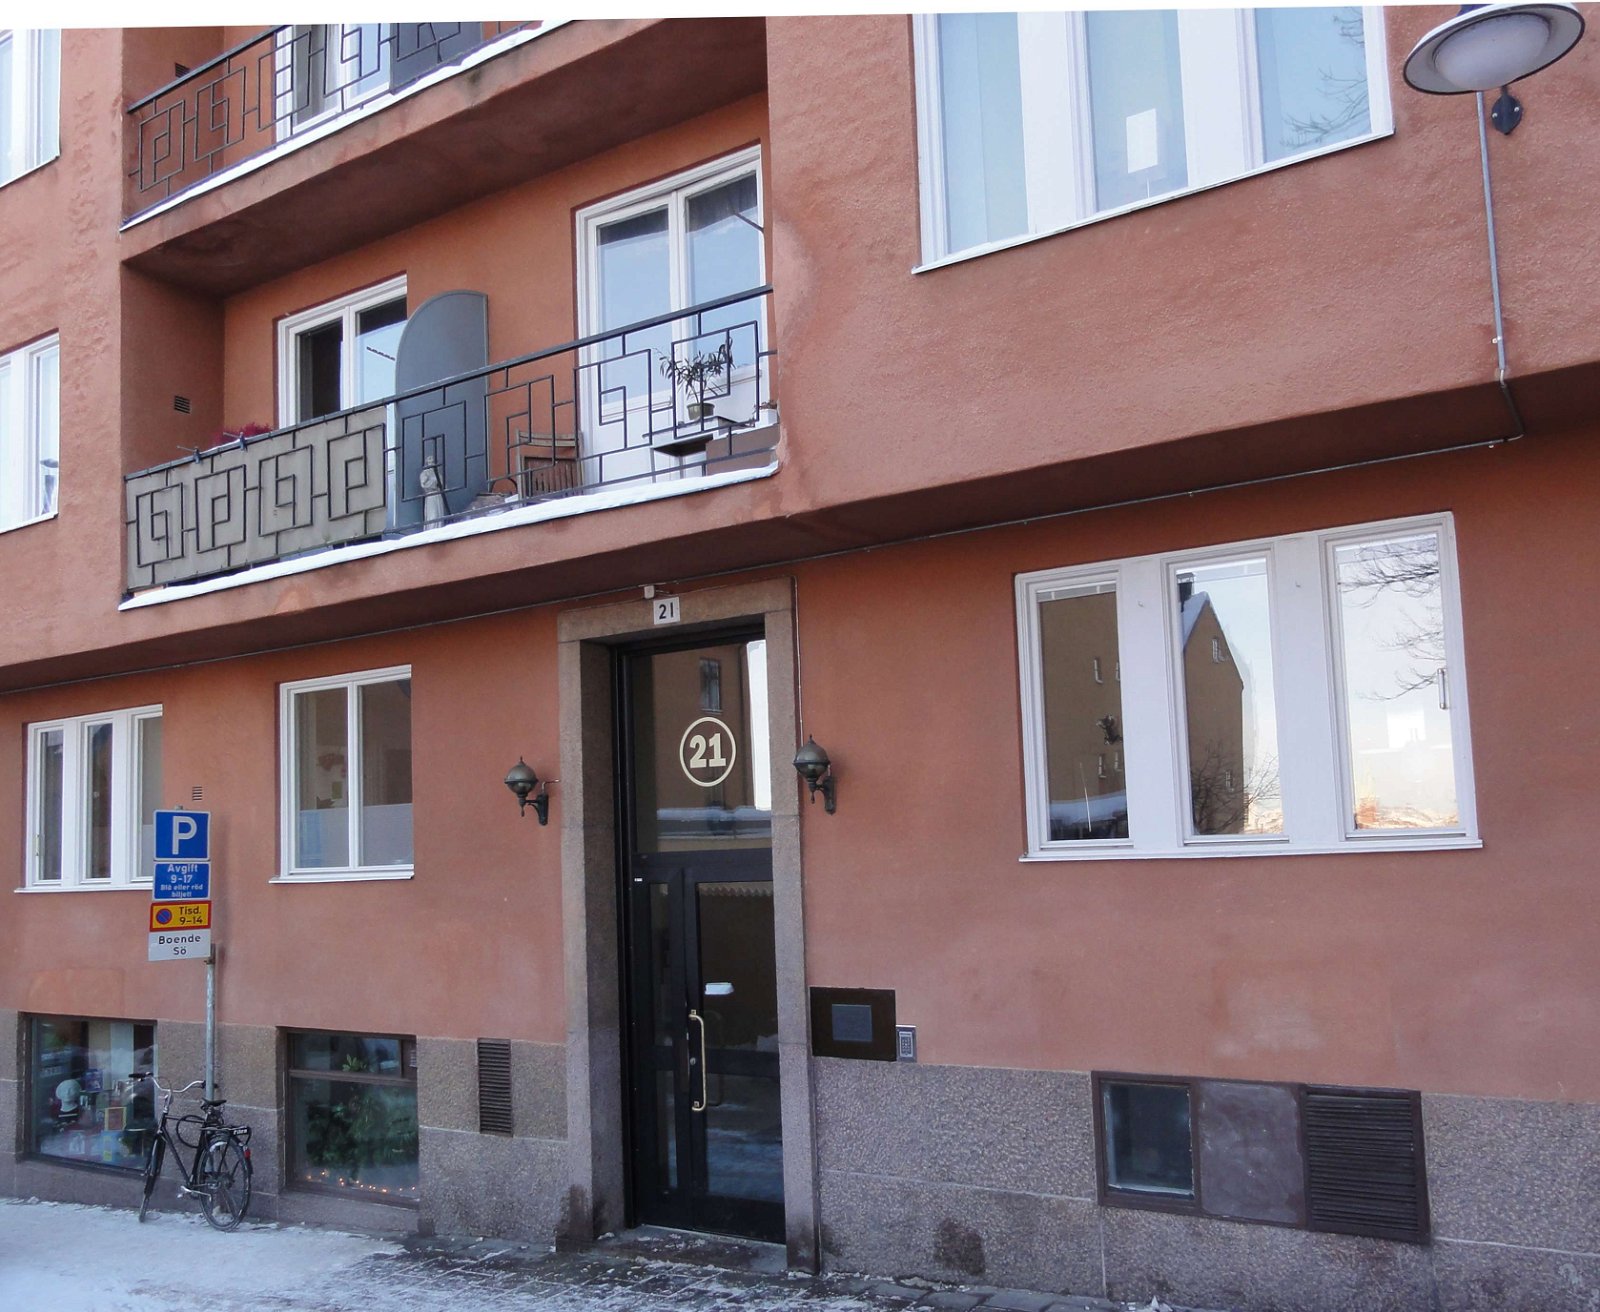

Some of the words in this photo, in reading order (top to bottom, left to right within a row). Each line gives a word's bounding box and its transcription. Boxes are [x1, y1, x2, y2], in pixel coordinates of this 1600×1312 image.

[658, 602, 675, 620] 21
[689, 732, 727, 769] 21
[172, 815, 198, 855] P
[167, 864, 198, 874] Avgift
[170, 874, 193, 884] 9-17
[179, 906, 202, 915] Tisd.
[179, 916, 203, 925] 9-14
[158, 934, 201, 945] Boende
[173, 946, 187, 956] Sö
